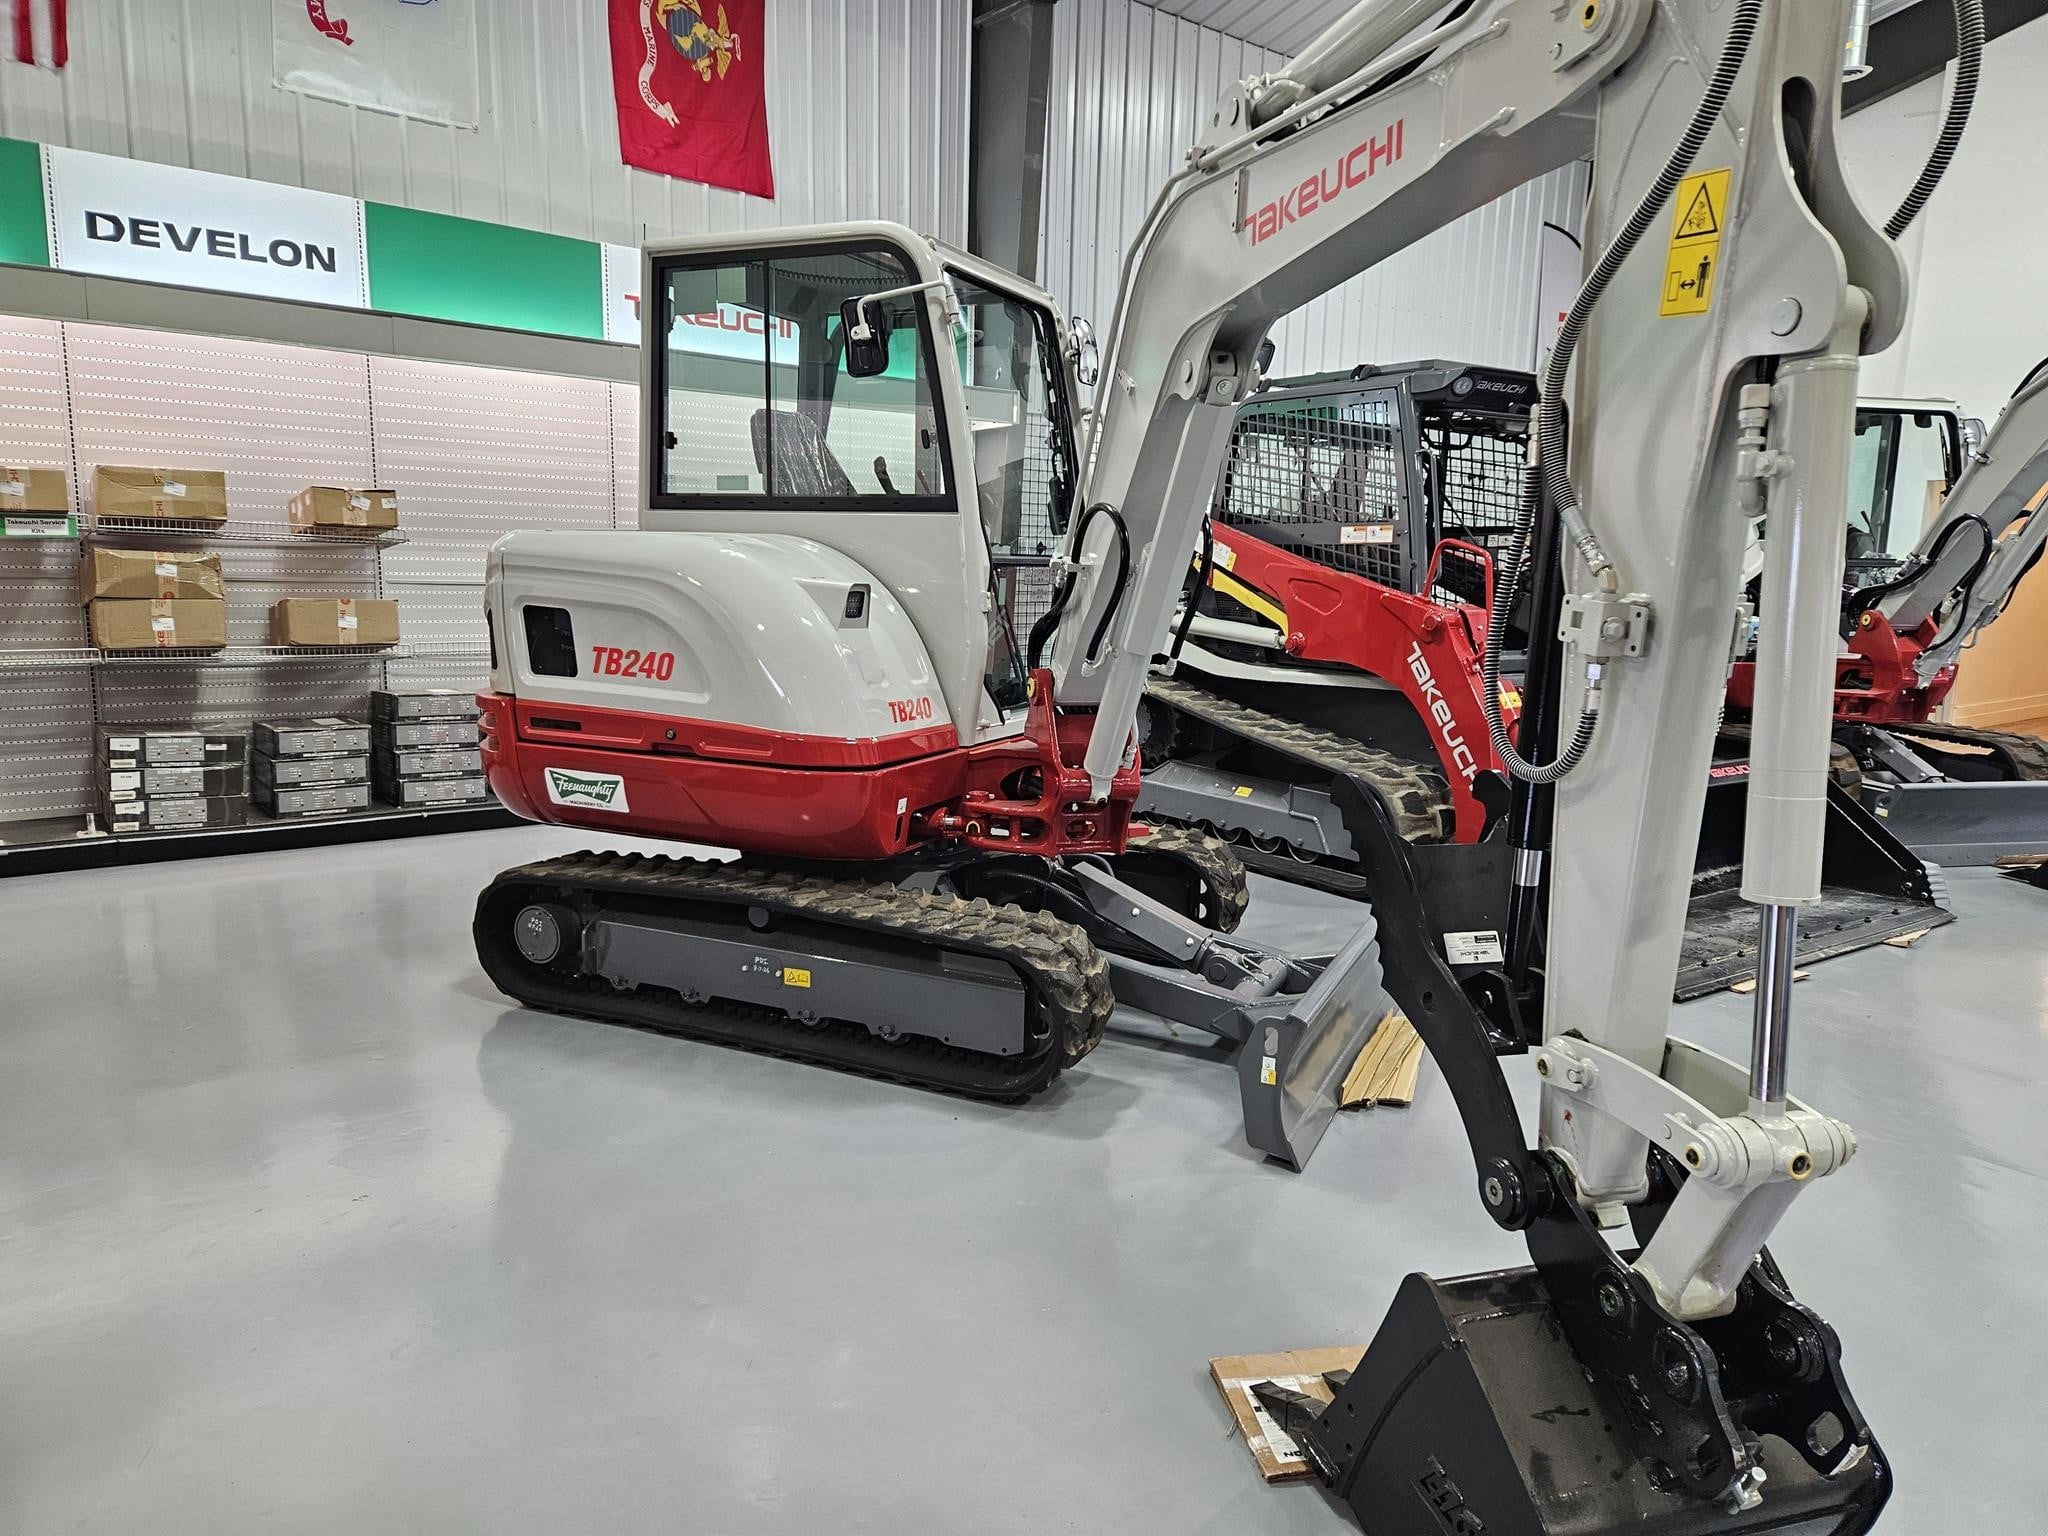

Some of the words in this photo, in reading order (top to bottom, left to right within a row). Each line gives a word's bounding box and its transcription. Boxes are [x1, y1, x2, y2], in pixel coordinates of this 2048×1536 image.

[642, 26, 657, 67] MARINE
[640, 80, 660, 110] CORPS
[1244, 118, 1404, 247] TAKEUCHI
[84, 210, 337, 273] DEVELON
[7, 518, 39, 526] Takeuchi
[40, 519, 66, 527] Service
[592, 645, 676, 681] TB240
[887, 696, 933, 725] TB240
[1406, 640, 1478, 792] TAKEUCH
[552, 773, 616, 802] Feenaughty
